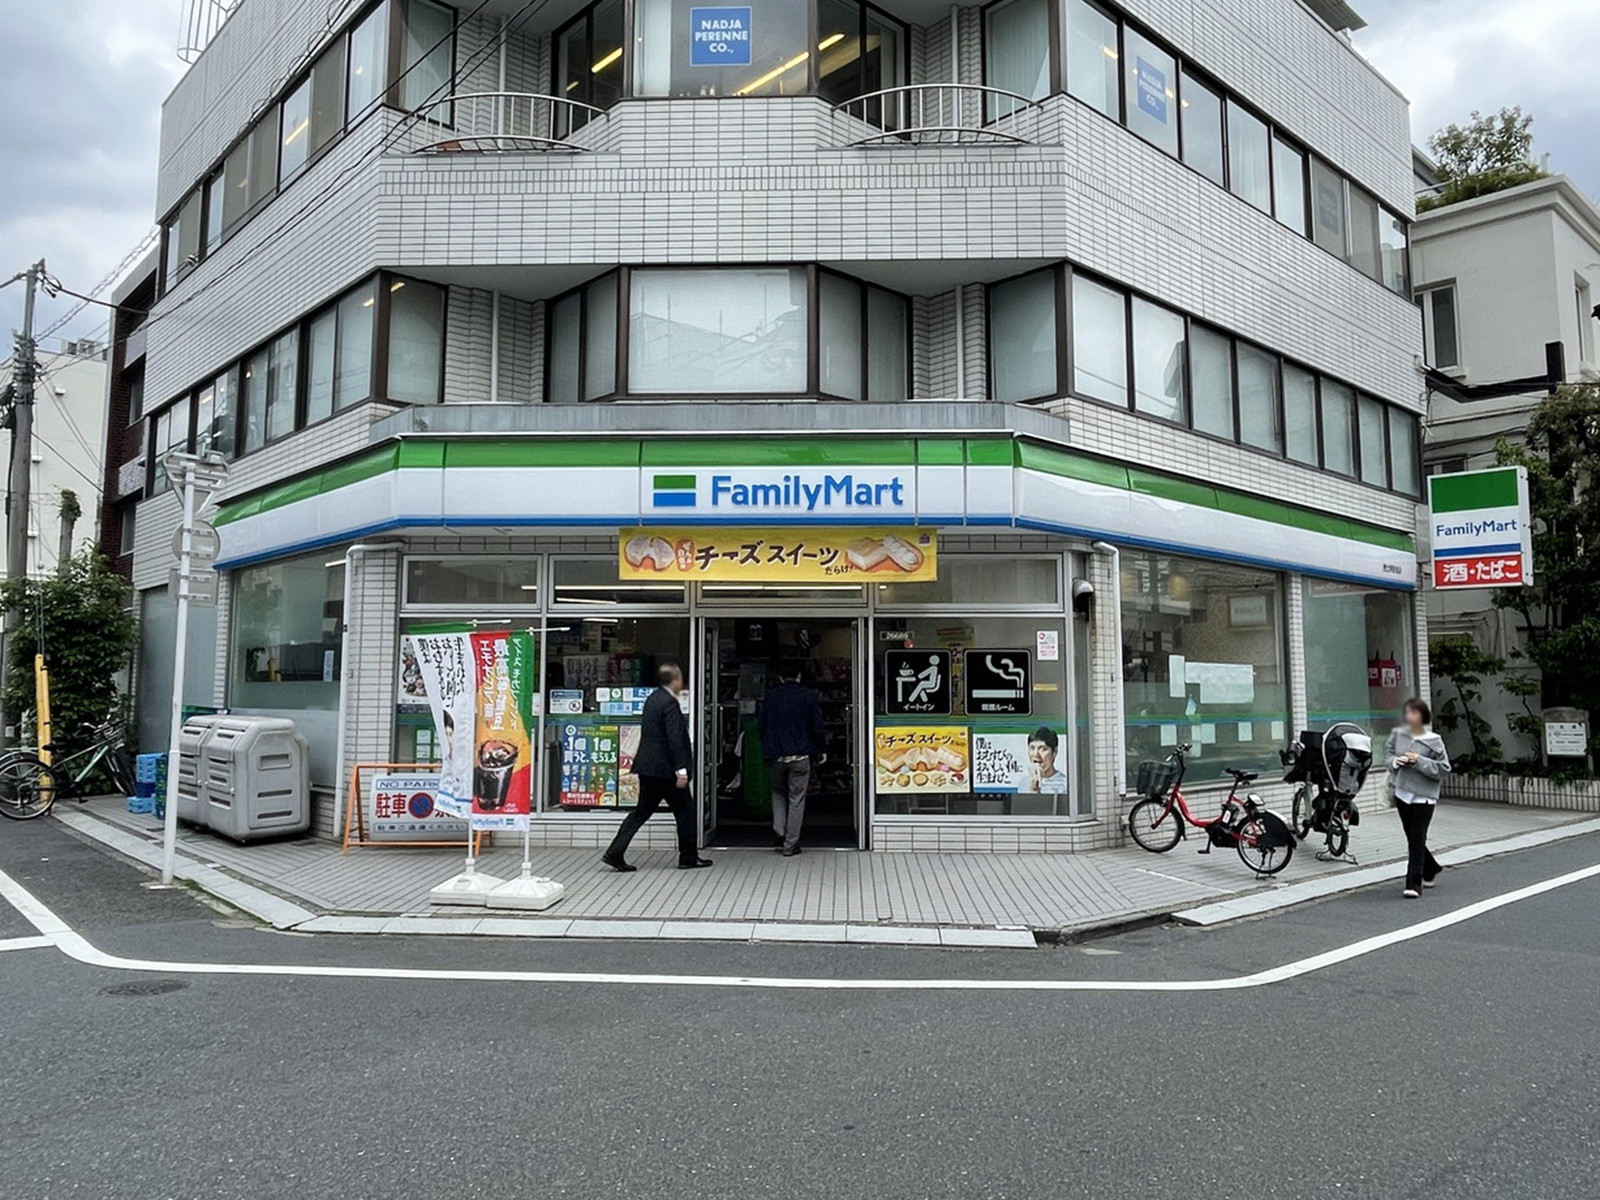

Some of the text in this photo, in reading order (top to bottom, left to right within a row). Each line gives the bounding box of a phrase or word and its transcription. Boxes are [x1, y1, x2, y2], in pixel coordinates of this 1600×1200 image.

[701, 19, 742, 30] NADJA
[695, 30, 749, 42] PERENNE
[711, 475, 904, 511] FamilyMart
[1436, 519, 1517, 537] FamilyMart
[1443, 560, 1519, 583] 酒・たばこ
[379, 780, 440, 788] NO PARK
[375, 793, 407, 818] 駐車
